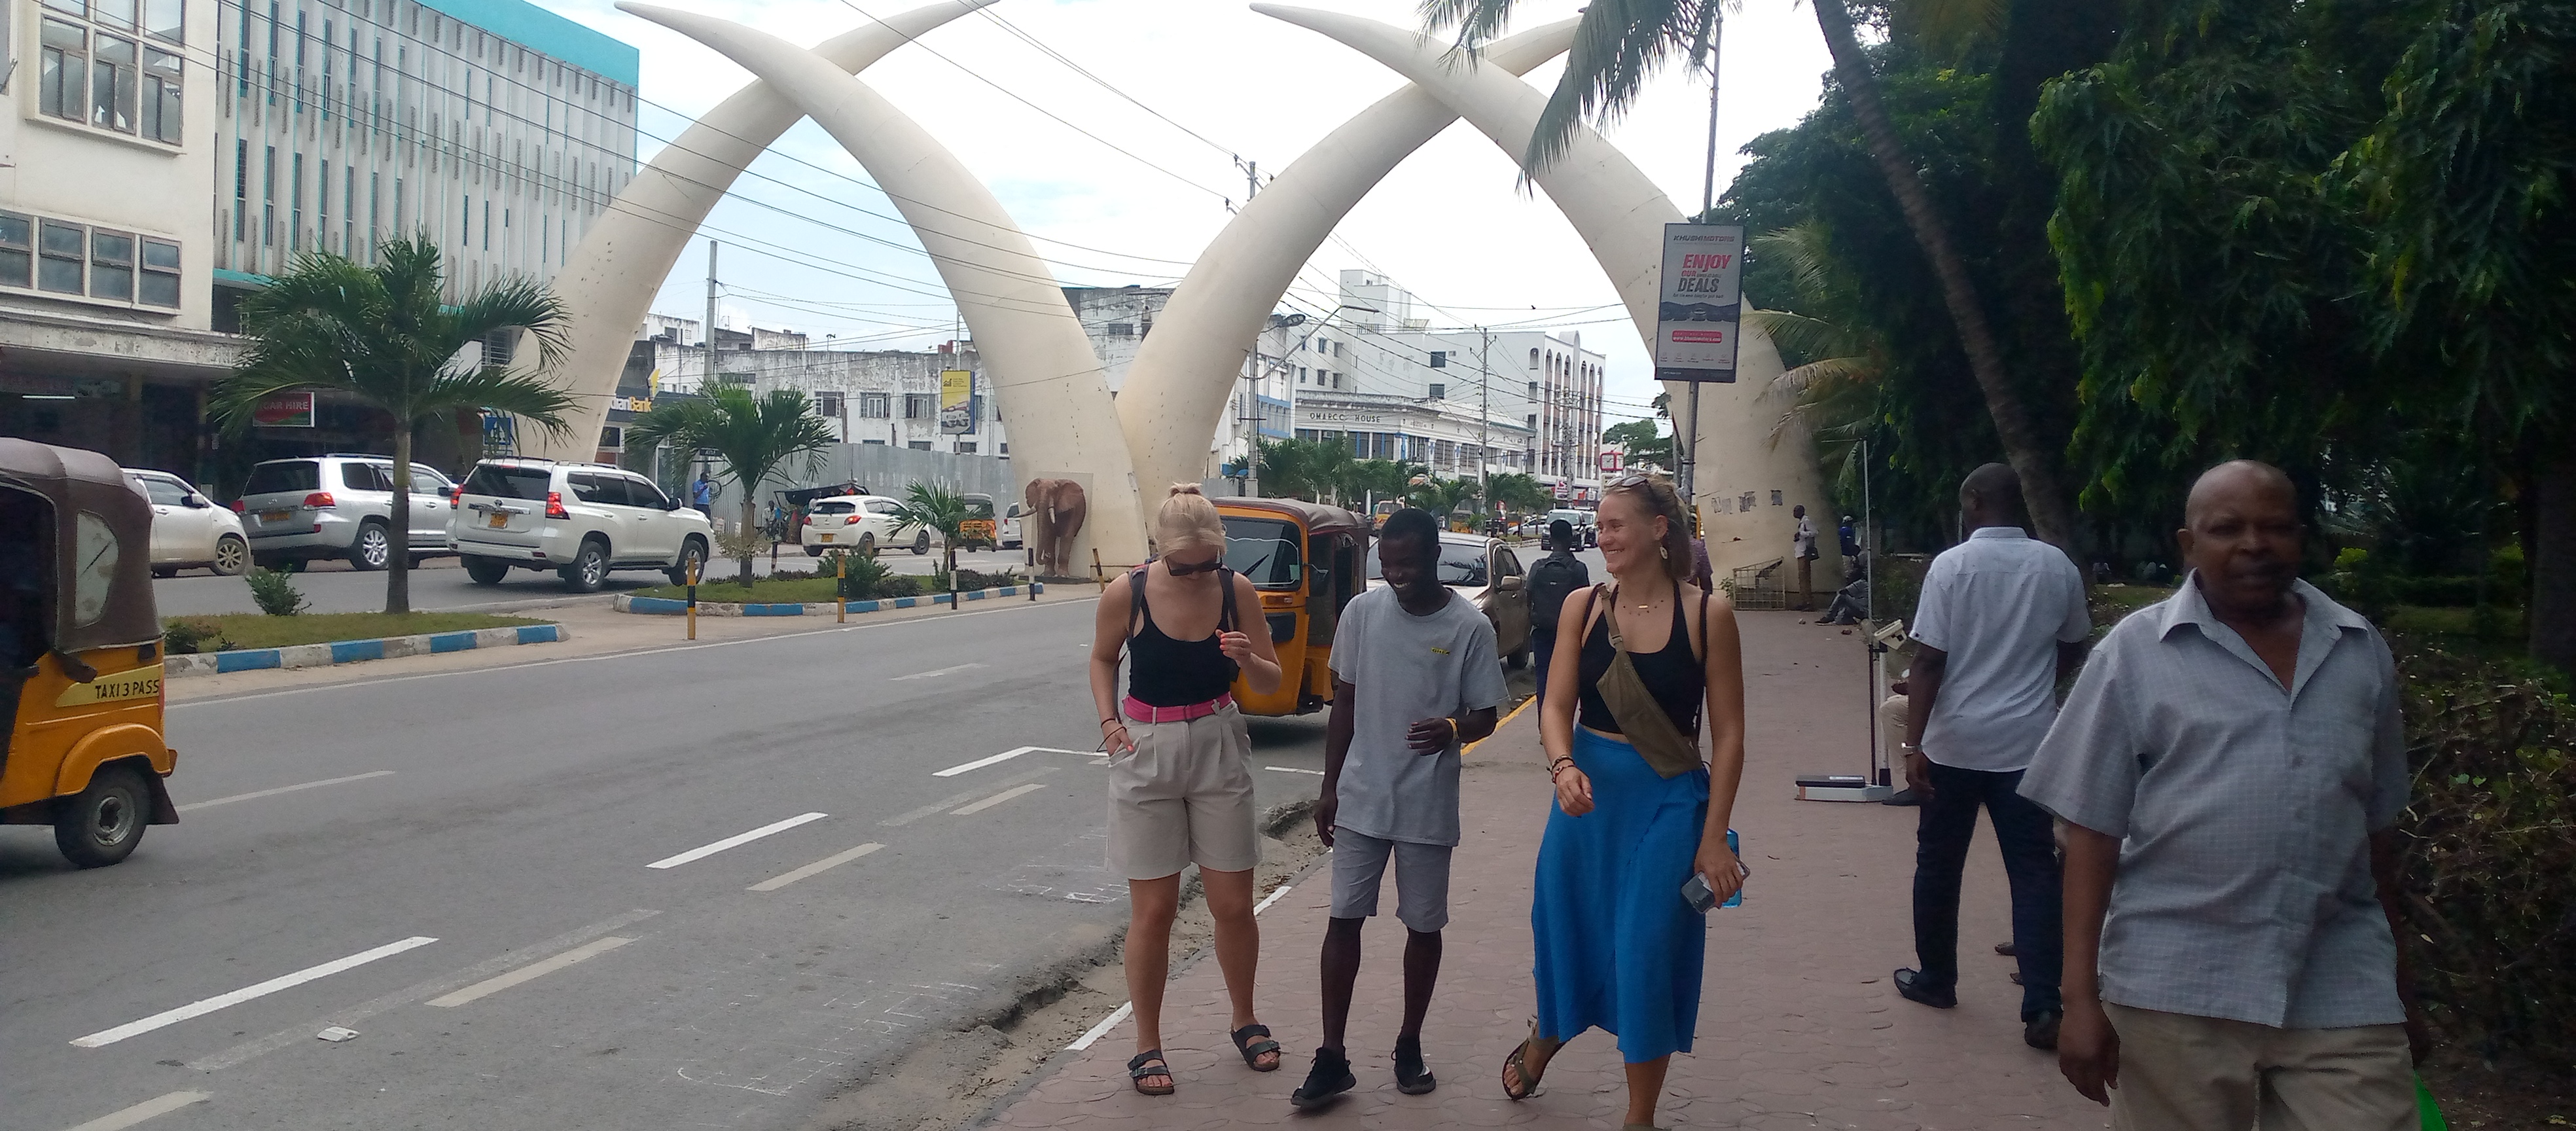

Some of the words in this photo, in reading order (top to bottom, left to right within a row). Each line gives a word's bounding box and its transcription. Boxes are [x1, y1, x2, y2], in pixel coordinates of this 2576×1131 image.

[1683, 254, 1732, 272] ENJOY
[1677, 278, 1719, 293] DEALS
[263, 401, 283, 410] CAR
[285, 401, 309, 410] HIRE
[1355, 414, 1380, 423] HOUSE
[95, 683, 120, 699] TAXI
[122, 683, 129, 696] 3
[132, 679, 160, 696] PASS
